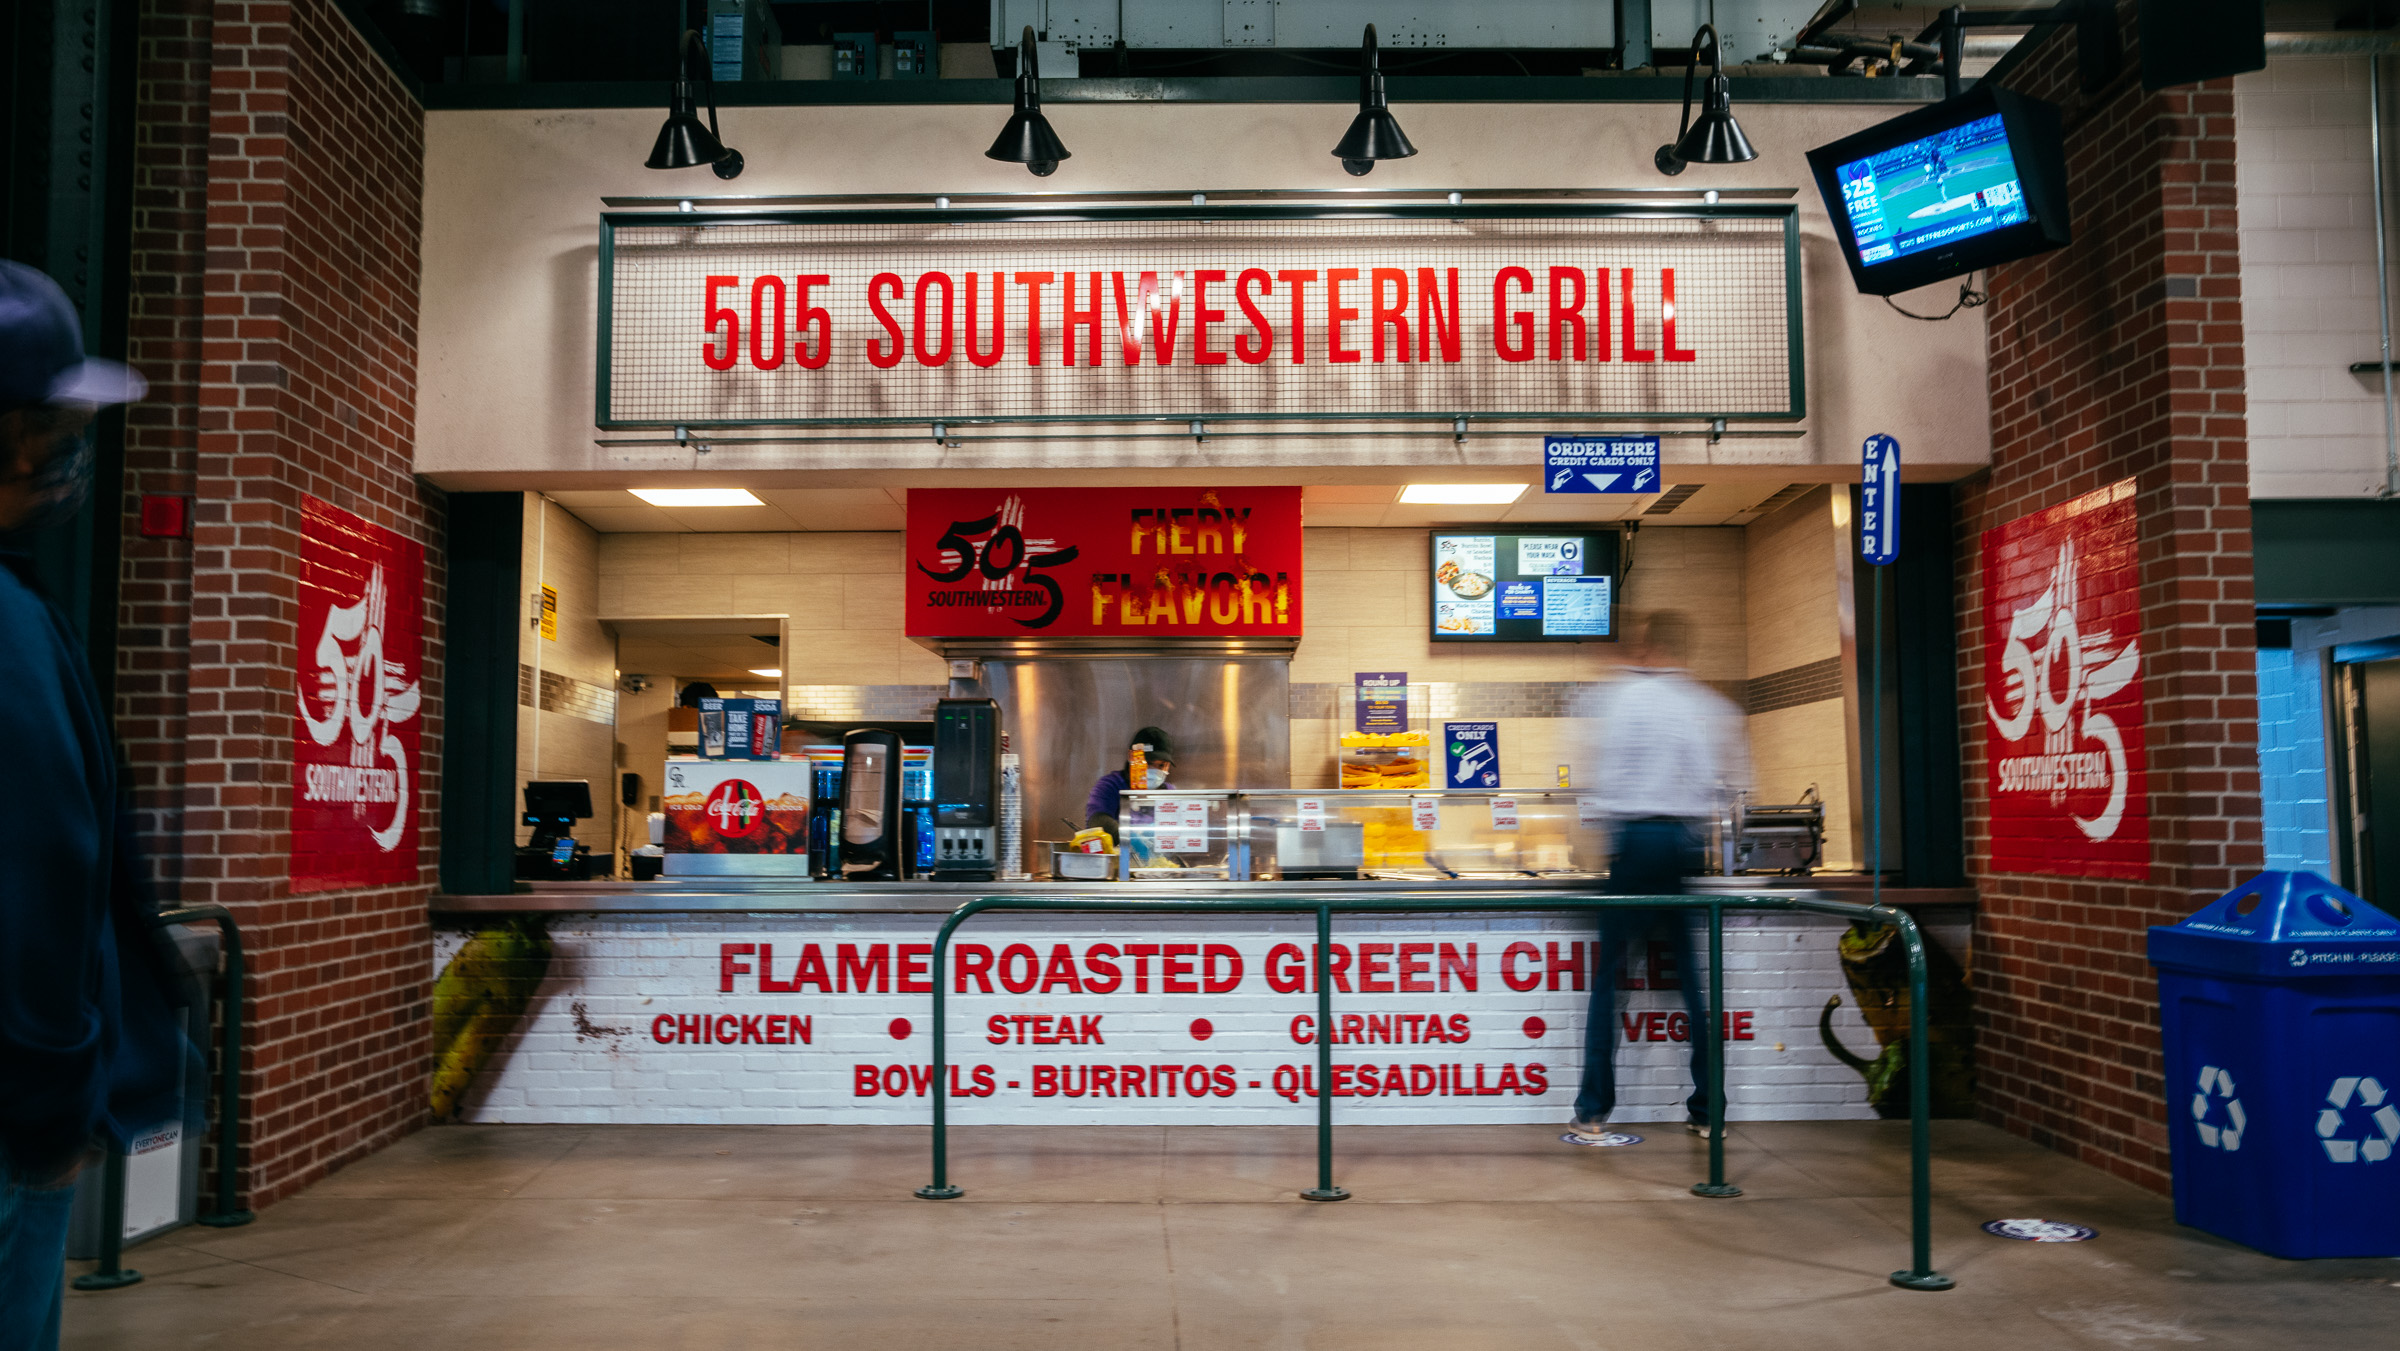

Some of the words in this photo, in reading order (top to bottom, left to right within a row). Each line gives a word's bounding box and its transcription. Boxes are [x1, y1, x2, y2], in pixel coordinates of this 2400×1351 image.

[1842, 175, 1876, 201] $25
[1847, 194, 1879, 214] FREE
[702, 274, 831, 370] 505
[867, 268, 1461, 368] SOUTHWESTERN
[1494, 266, 1696, 363] GRILL
[1548, 442, 1607, 456] ORDER
[1611, 442, 1656, 456] HERE
[1549, 457, 1588, 466] CREDIT
[1589, 457, 1625, 466] CARDS
[1626, 457, 1656, 466] ONLY
[1863, 440, 1879, 555] ENTER
[1130, 507, 1251, 555] FIERY
[916, 513, 1079, 629] 505
[926, 589, 1045, 608] SOUTHWESTERN
[1091, 571, 1289, 626] FLAVOR!
[298, 595, 421, 853] 505
[703, 702, 723, 710] BEER
[754, 703, 777, 711] SODA
[1985, 583, 2141, 844] 505
[1456, 731, 1487, 740] ONLY
[304, 763, 398, 803] SOUTHWESTERN
[1998, 750, 2106, 793] SOUTHWESTERN
[719, 943, 933, 994] FLAME
[954, 943, 1243, 995] ROASTED
[1264, 942, 1478, 993] GREEN
[651, 1013, 812, 1045] CHICKEN
[986, 1014, 1104, 1045] STEAK
[1290, 1013, 1471, 1045] CARNITAS
[1621, 1011, 1755, 1042] VEGIE
[854, 1064, 996, 1098] BOWLS
[1032, 1064, 1238, 1099] BURRITOS
[1273, 1063, 1549, 1103] QUESADILLAS
